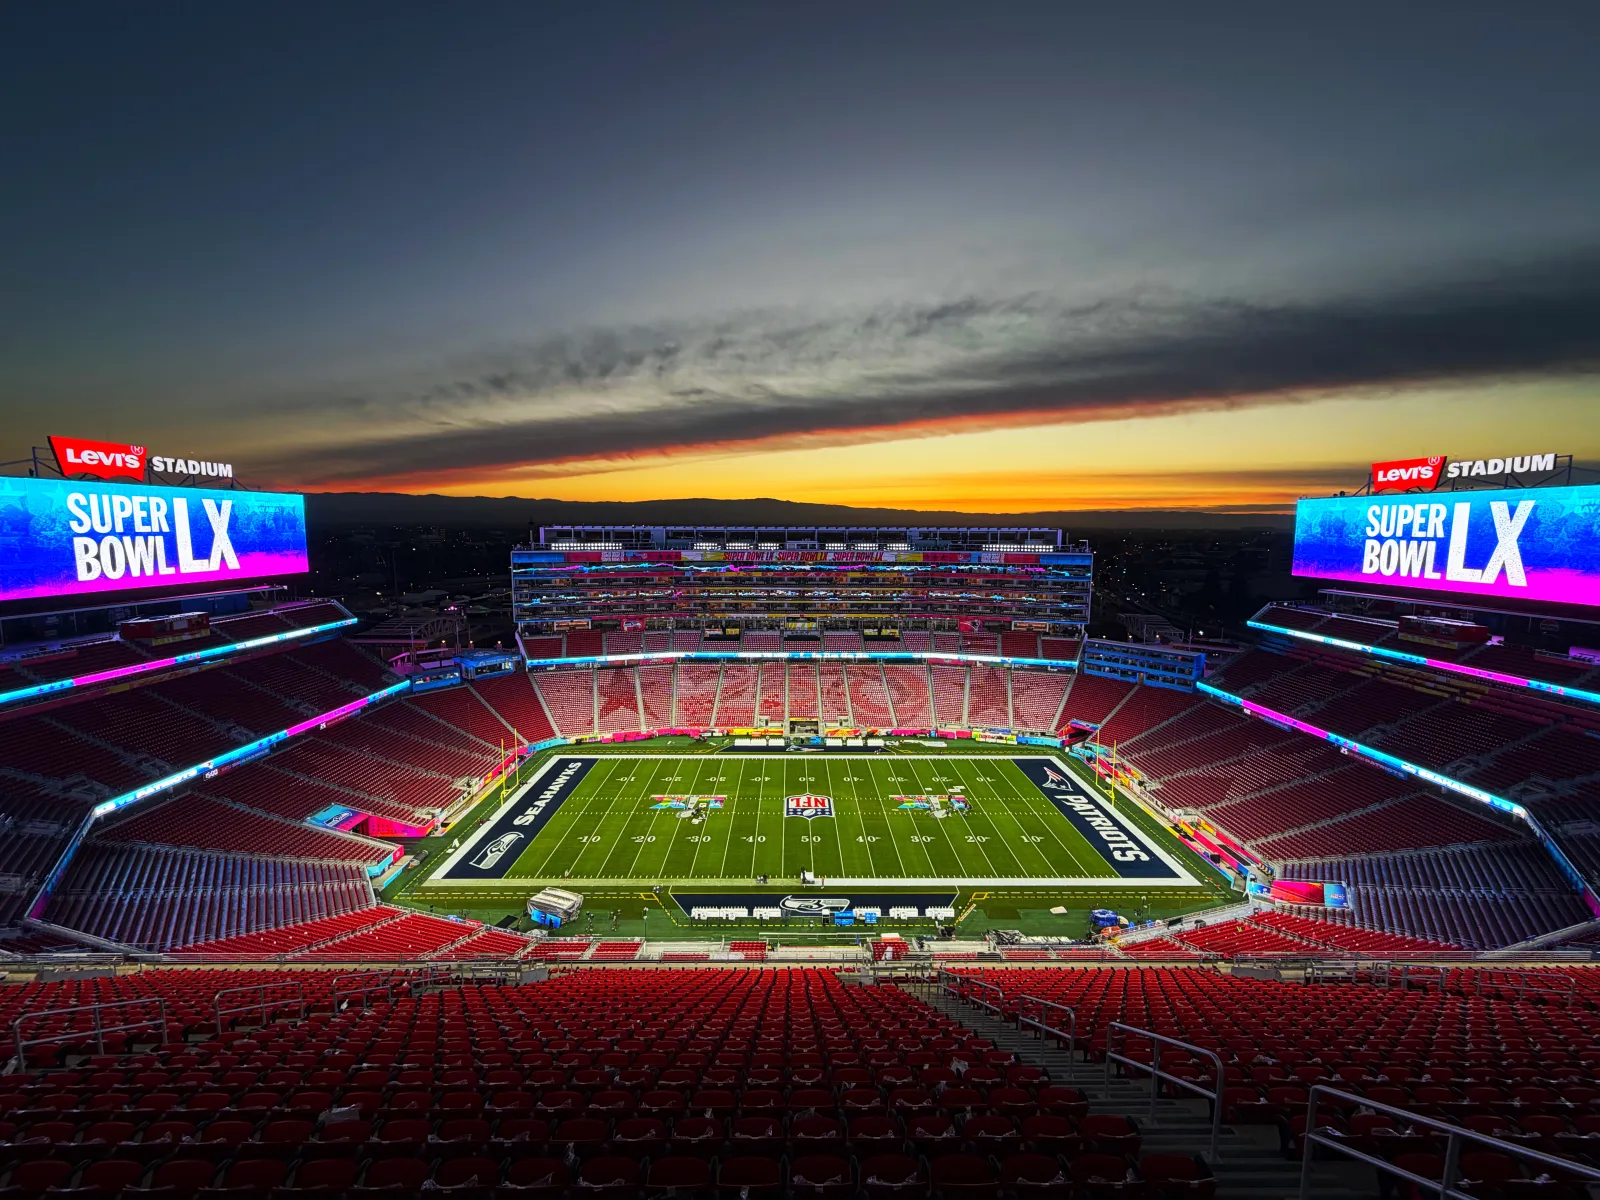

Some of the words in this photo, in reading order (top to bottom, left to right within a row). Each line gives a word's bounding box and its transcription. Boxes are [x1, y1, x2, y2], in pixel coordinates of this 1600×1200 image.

[152, 456, 233, 478] STADIUM
[1447, 453, 1556, 478] STADIUM
[66, 492, 170, 534] SUPER
[1366, 503, 1447, 538] SUPER
[173, 497, 240, 574] LX
[1445, 500, 1536, 587] LX
[73, 535, 175, 582] BOWL
[723, 552, 745, 560] SUPER
[777, 552, 799, 560] SUPER
[800, 552, 818, 560] BOWL
[819, 552, 828, 560] LX
[832, 552, 852, 560] SUPER
[1362, 539, 1441, 580] BOWL
[136, 769, 198, 799] PATRIOTS
[513, 762, 582, 827] SEAHAWKS
[1418, 768, 1491, 803] SEAHAWKS
[790, 796, 827, 808] NFL
[1055, 795, 1149, 862] PATRIOTS
